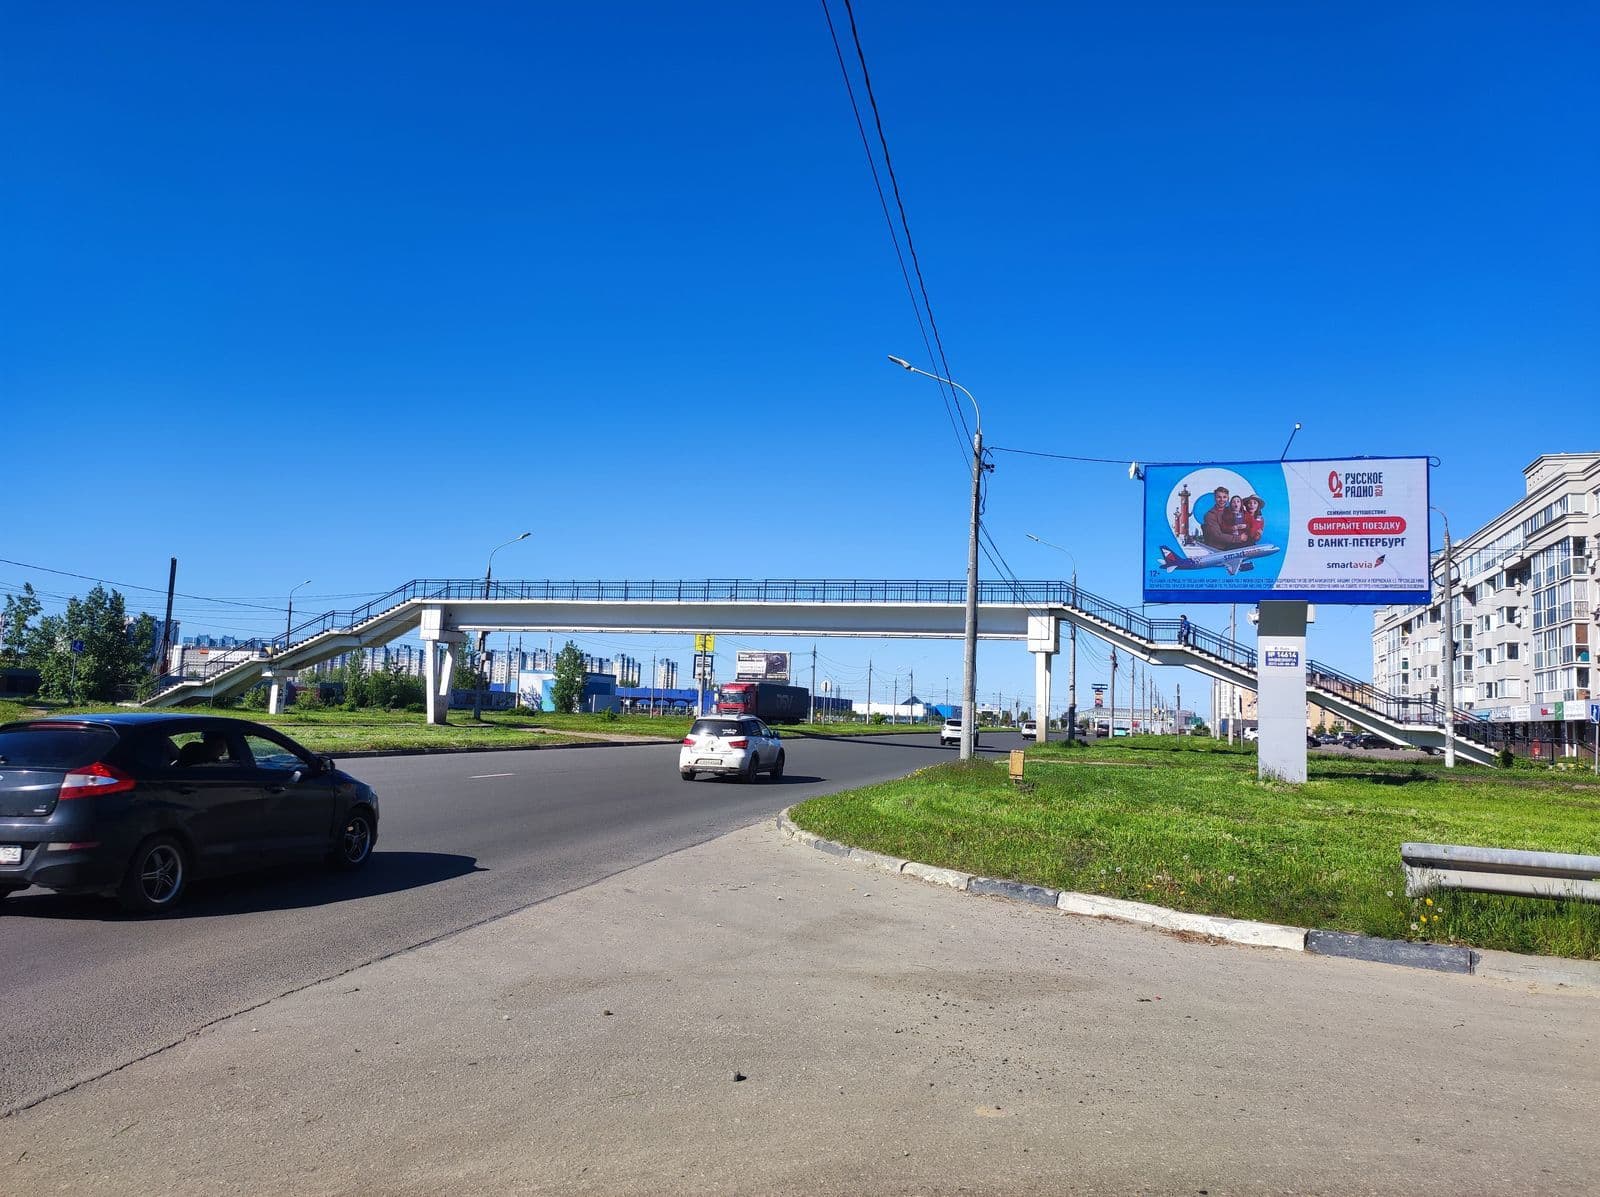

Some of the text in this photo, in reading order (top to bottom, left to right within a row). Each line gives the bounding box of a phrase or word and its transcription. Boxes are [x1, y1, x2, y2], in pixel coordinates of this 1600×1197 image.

[1345, 472, 1383, 484] РУССКОЕ
[1345, 485, 1373, 497] РАДИО
[1313, 521, 1400, 530] ВЫИГРАЙТЕ ПОЕЗДКУ
[1308, 537, 1406, 548] В САНКТ-ПЕТЕРБУРГ
[1326, 560, 1373, 569] smartavia
